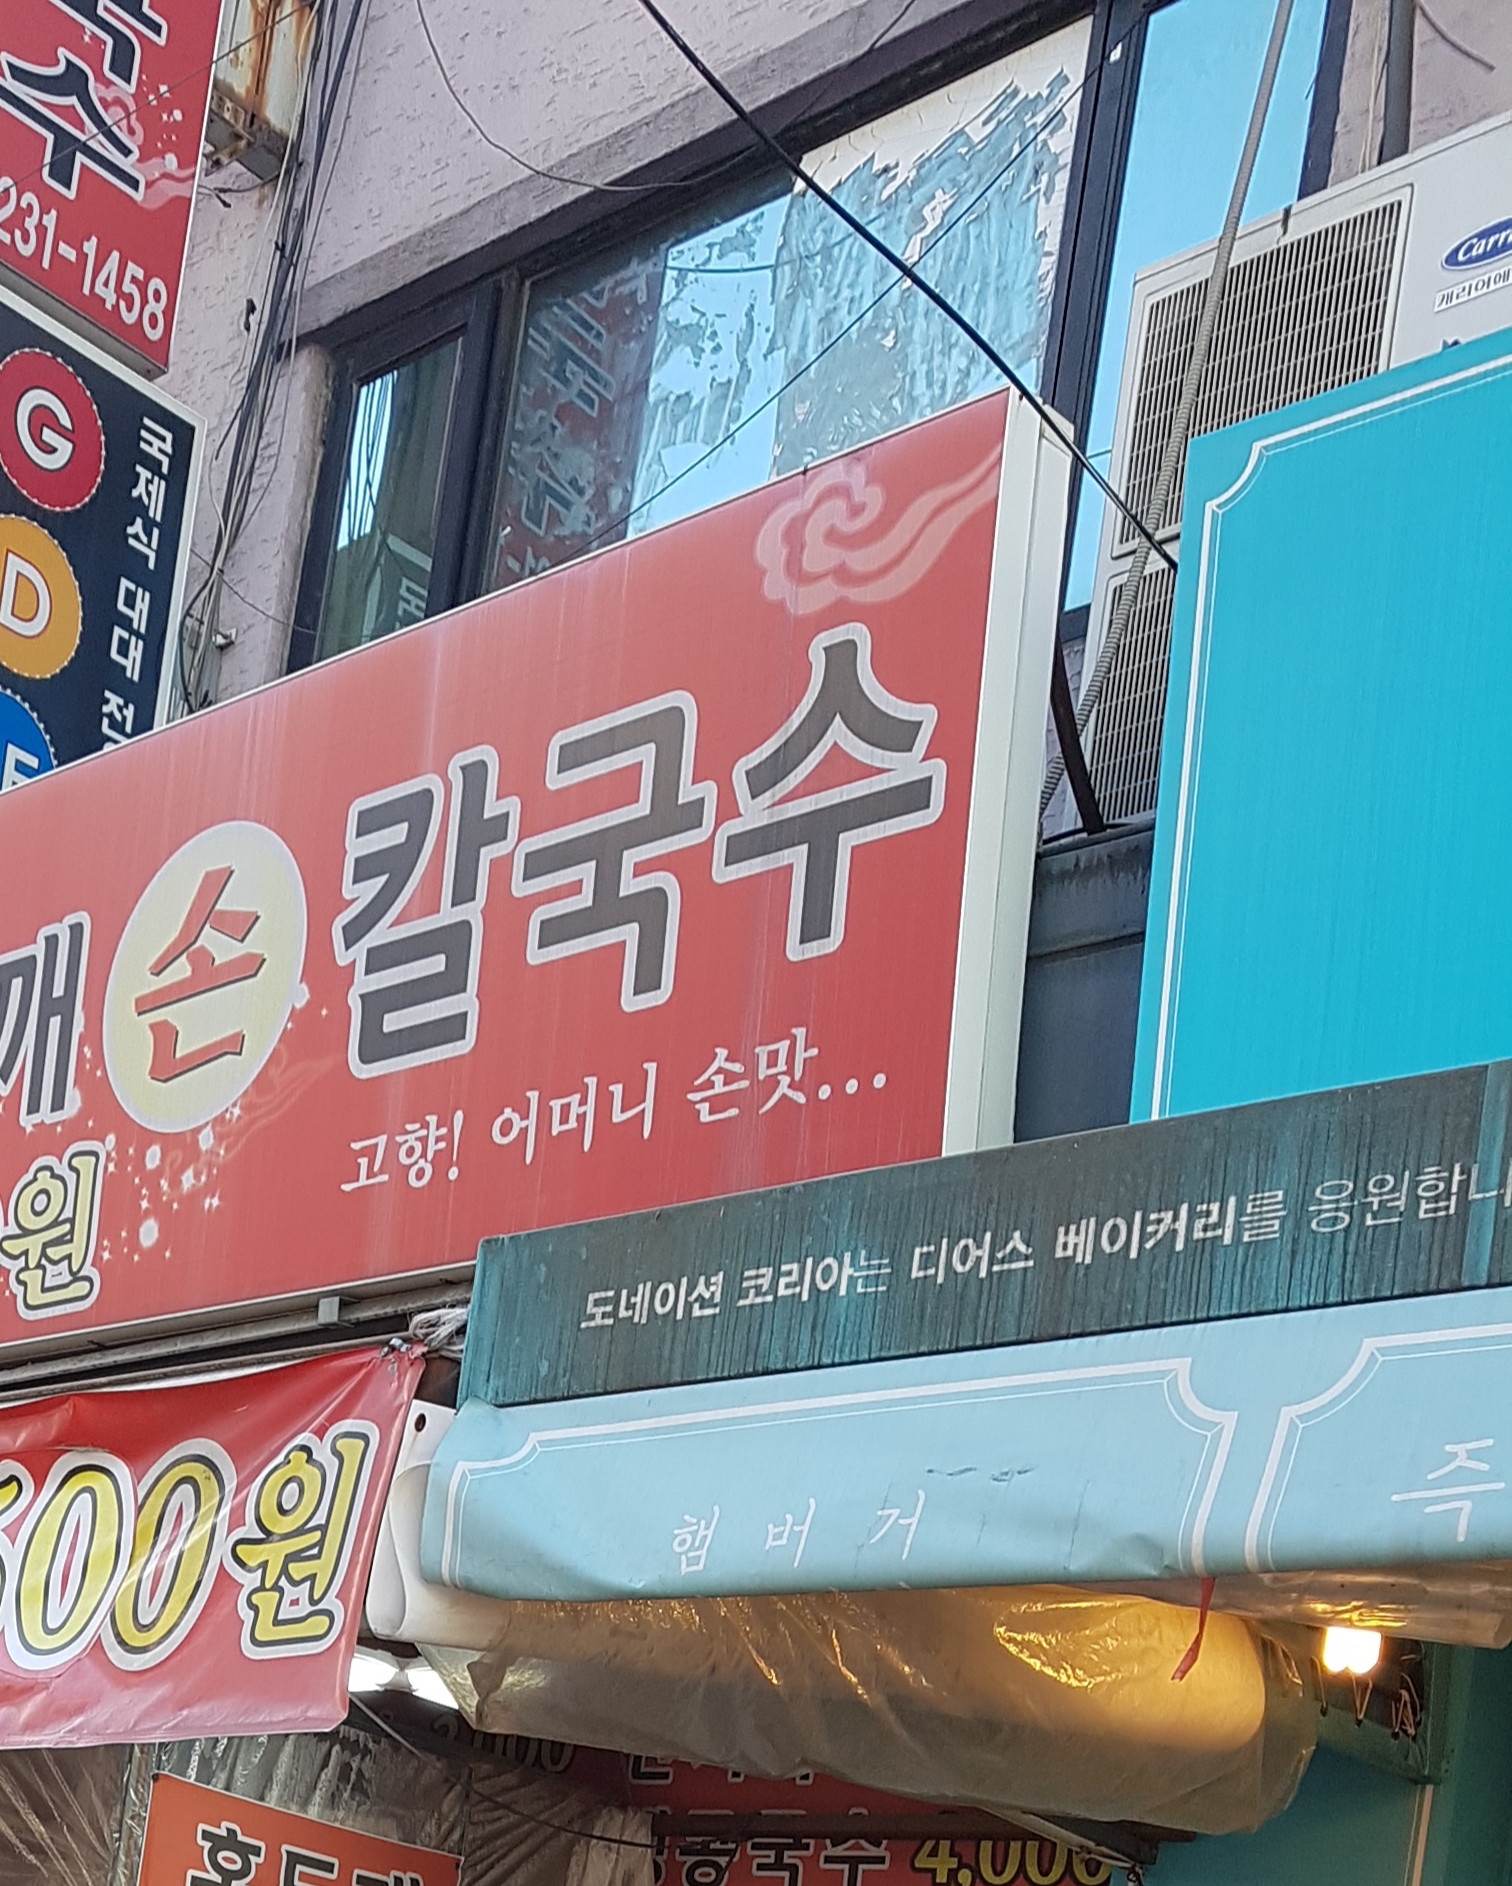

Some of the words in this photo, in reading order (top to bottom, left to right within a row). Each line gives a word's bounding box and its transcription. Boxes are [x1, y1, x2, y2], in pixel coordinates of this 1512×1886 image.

[16, 387, 74, 471] G
[126, 416, 174, 571] 국제식
[109, 577, 150, 682] 대대
[101, 688, 135, 752] 전
[134, 866, 265, 1083] 손
[333, 622, 947, 1079] 칼국수
[341, 1110, 463, 1191] 고향!
[491, 1062, 656, 1163] 어머니
[688, 1027, 887, 1123] 손맛...
[580, 1270, 724, 1330] 도네이션
[736, 1249, 891, 1308] 코리아는
[910, 1230, 1034, 1285] 디어스
[1054, 1189, 1287, 1265] 베이커리를
[1392, 1438, 1505, 1542] 즉
